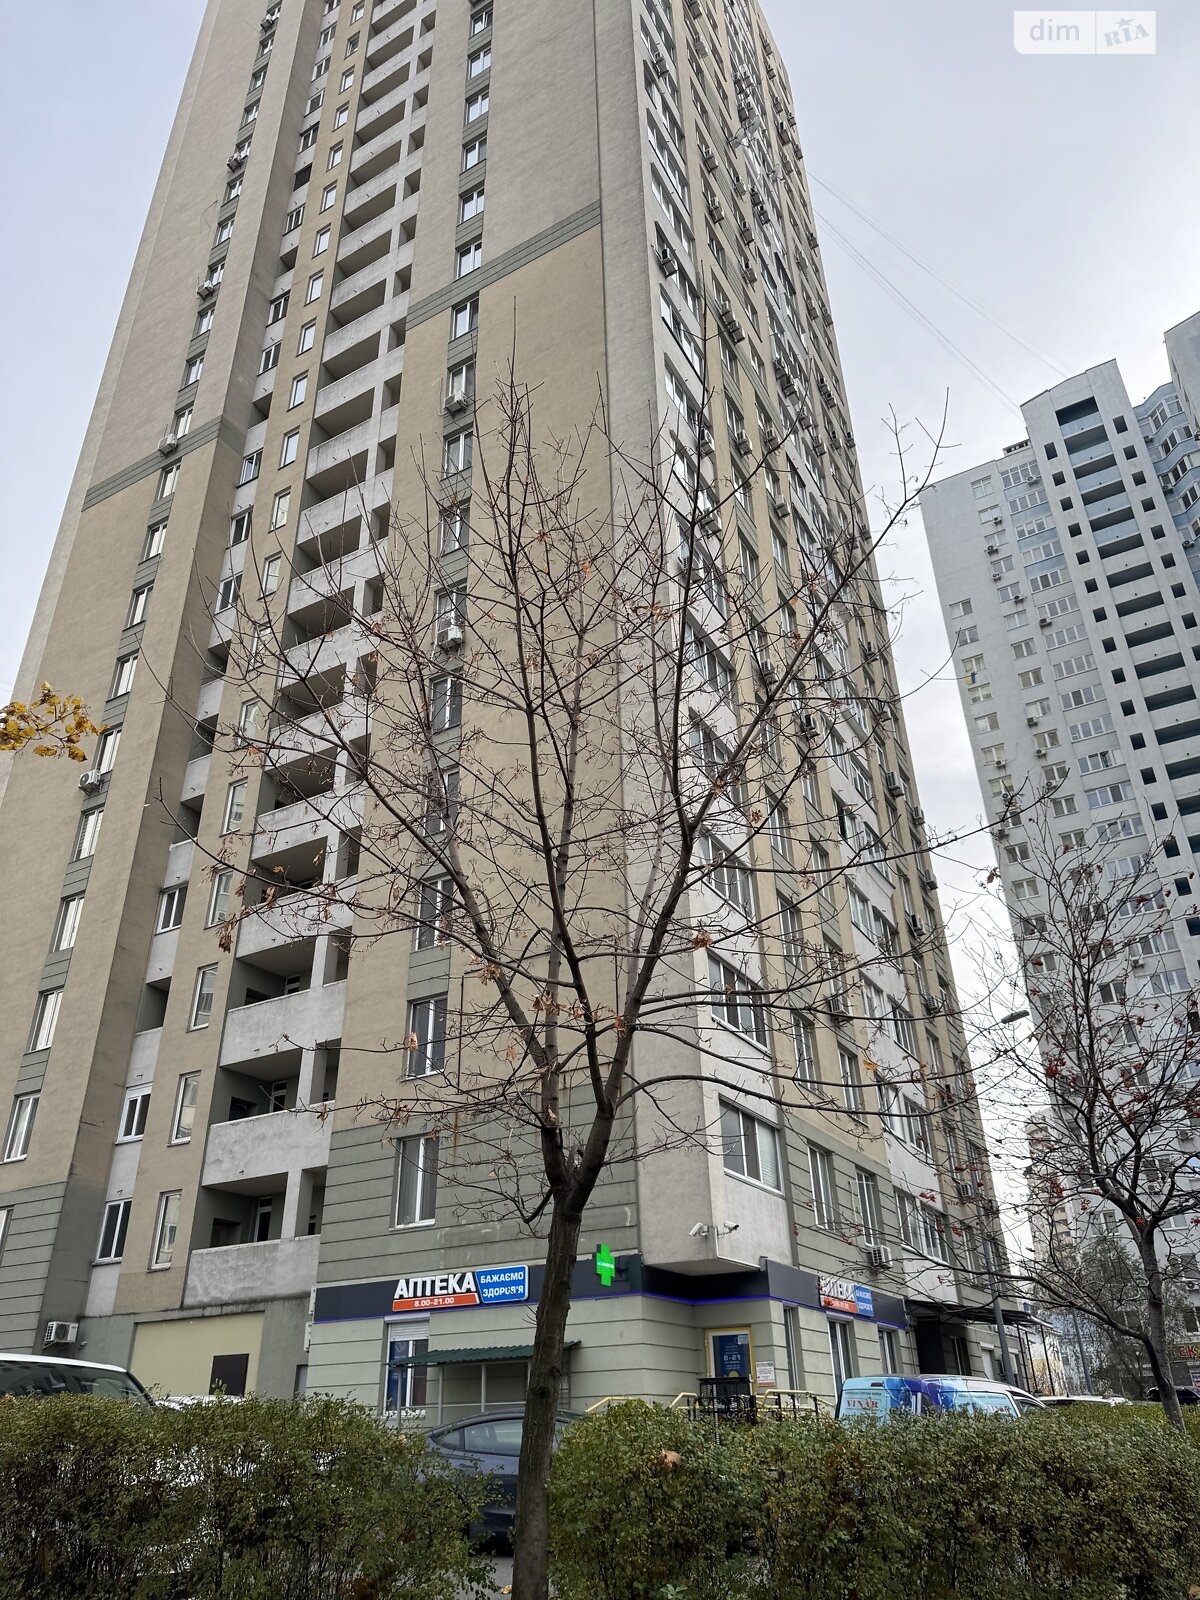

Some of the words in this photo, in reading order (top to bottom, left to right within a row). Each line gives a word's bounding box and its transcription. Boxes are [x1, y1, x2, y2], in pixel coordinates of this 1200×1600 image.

[480, 1271, 524, 1284] БАЖАЄМО
[394, 1272, 477, 1299] АПТЕКА
[414, 1297, 455, 1307] 8.00-21.00
